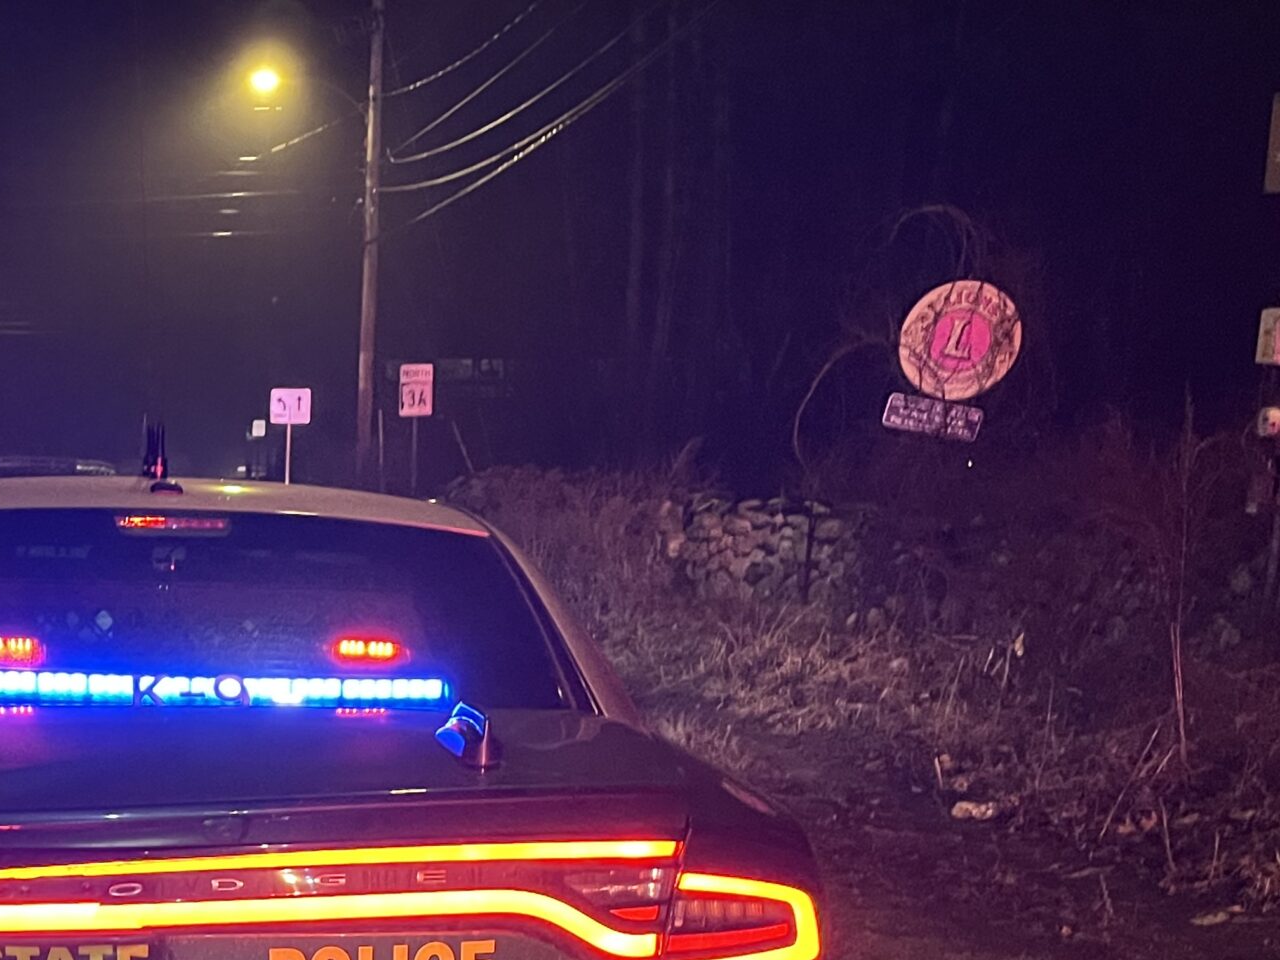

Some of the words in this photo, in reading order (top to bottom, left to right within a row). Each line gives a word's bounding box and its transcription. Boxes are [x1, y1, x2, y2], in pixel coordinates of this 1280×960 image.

[402, 368, 431, 378] NORTH
[407, 389, 427, 408] 3A
[133, 674, 251, 708] K-9
